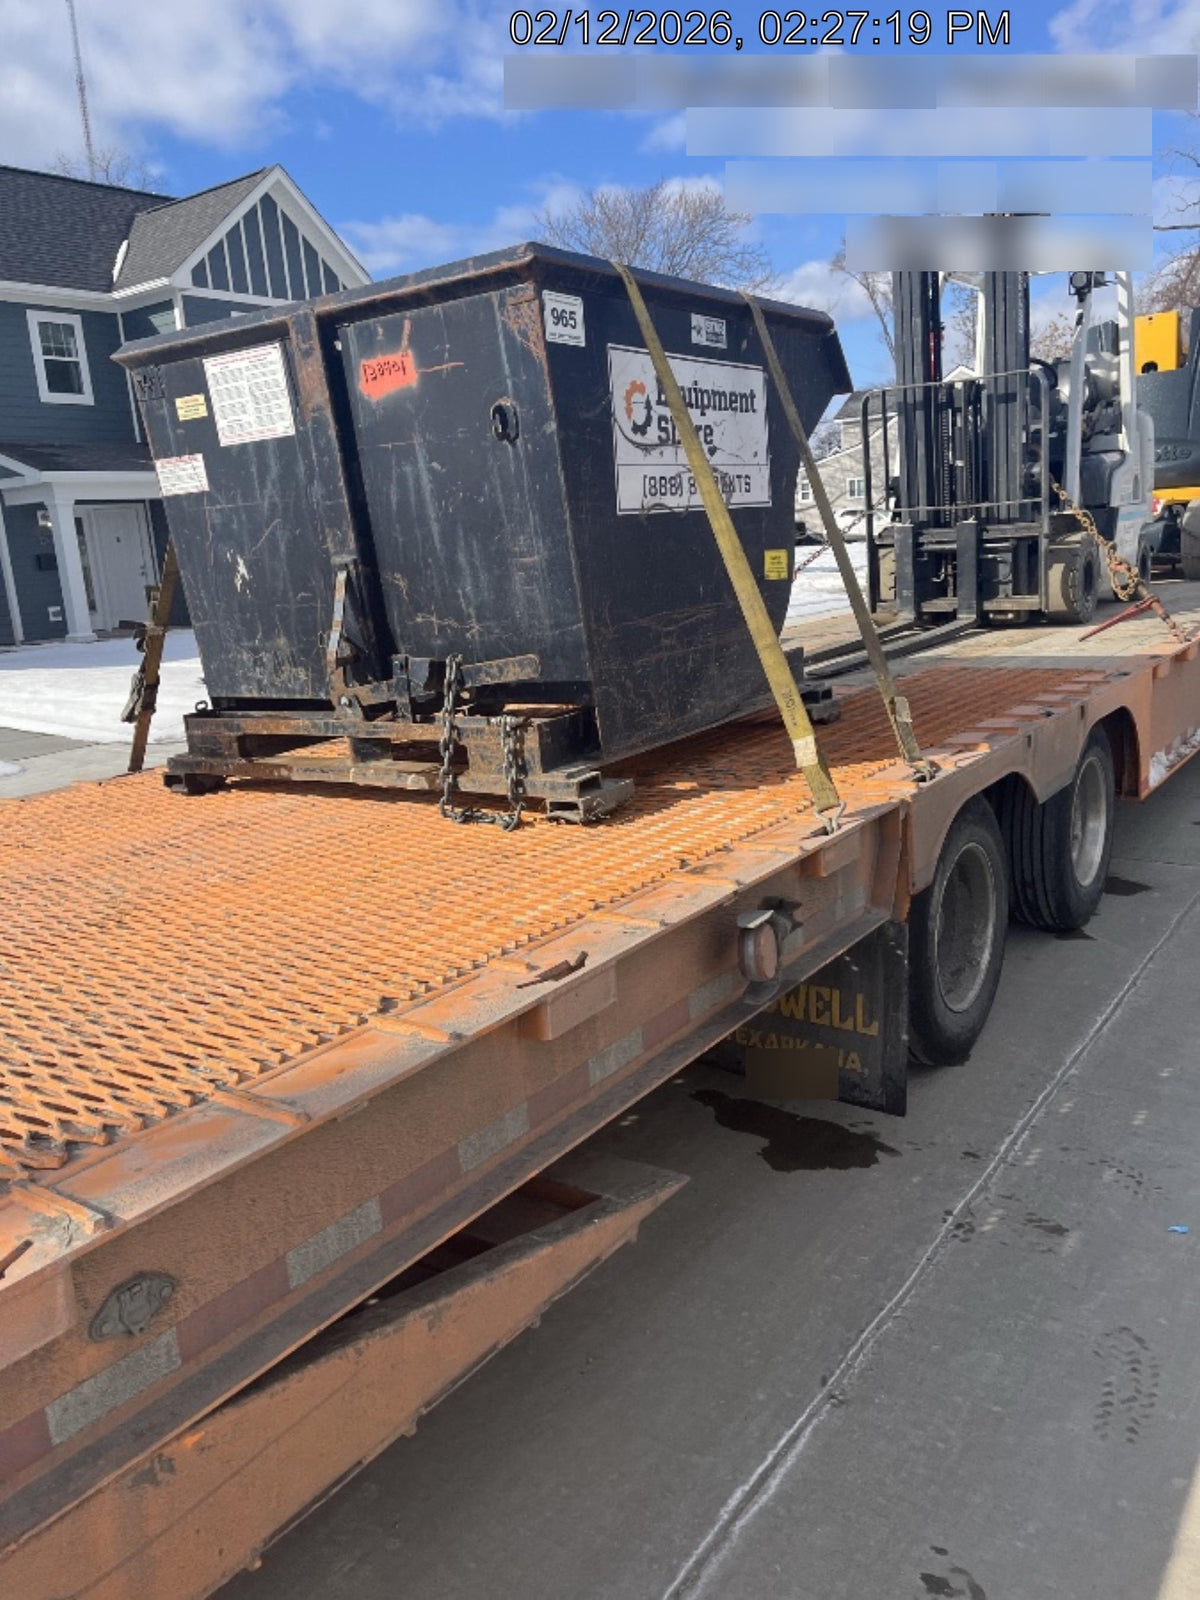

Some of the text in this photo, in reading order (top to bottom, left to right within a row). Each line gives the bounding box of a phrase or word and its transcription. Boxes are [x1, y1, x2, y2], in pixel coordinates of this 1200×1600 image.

[551, 307, 577, 329] 965
[656, 377, 757, 417] Euipment
[657, 414, 714, 445] Sre
[766, 984, 880, 1037] WELL
